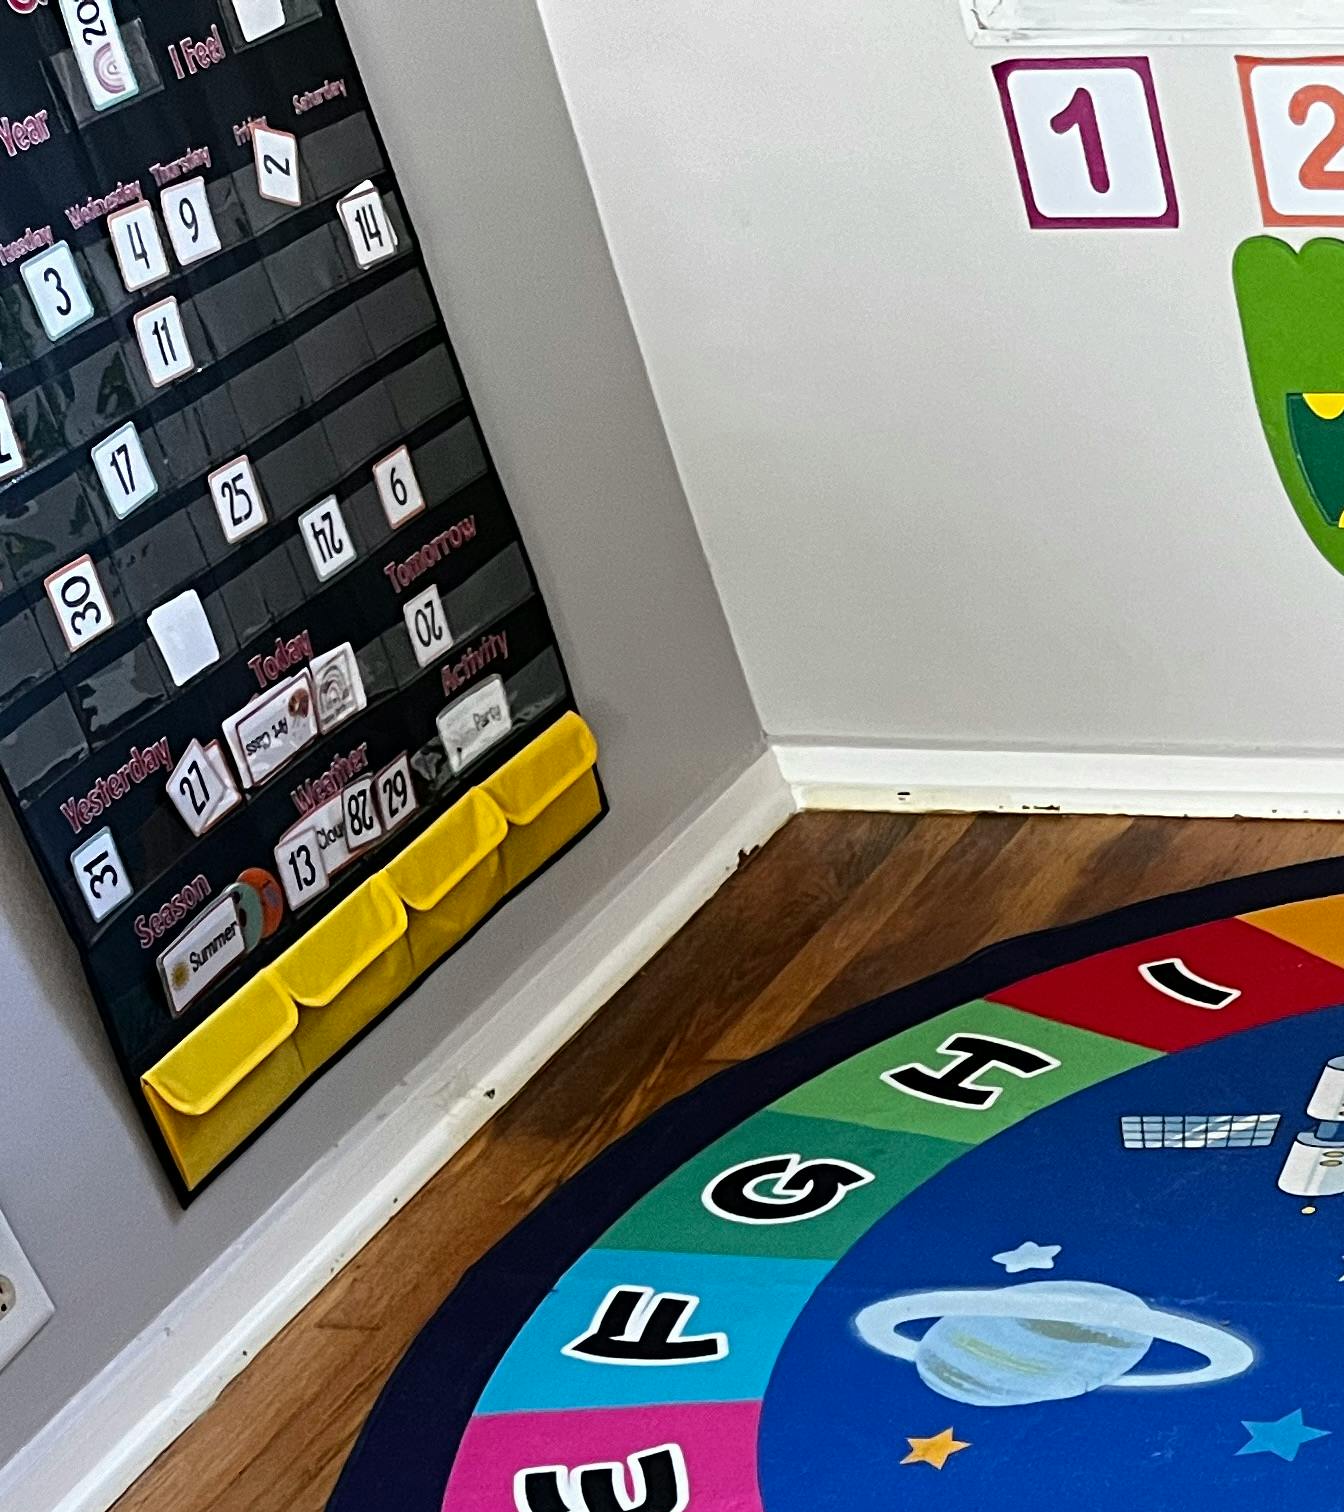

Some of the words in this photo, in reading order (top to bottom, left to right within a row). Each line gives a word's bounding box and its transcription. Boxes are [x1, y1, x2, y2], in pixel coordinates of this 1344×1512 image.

[168, 44, 185, 79] I
[181, 24, 227, 75] Feel
[293, 79, 347, 115] Saturday
[149, 147, 212, 187] Thursday
[263, 154, 290, 176] 2
[1049, 87, 1110, 194] 1
[64, 180, 143, 230] Wednesday
[354, 204, 383, 252] 14
[129, 221, 151, 270] 4
[43, 267, 72, 316] 3
[152, 317, 177, 366] 11
[110, 443, 136, 496] 17
[390, 467, 408, 506] 6
[221, 472, 253, 527] 25
[384, 514, 477, 594] Tomorrow
[61, 575, 101, 636] 30
[248, 629, 314, 688] Today
[440, 630, 509, 697] Activity
[59, 736, 174, 834] Yesterday
[180, 760, 210, 816] 27
[290, 742, 368, 816] Weather
[383, 770, 408, 818] 29
[83, 850, 118, 899] 31
[289, 844, 316, 892] 13
[134, 874, 212, 949] Season
[189, 922, 237, 972] Summer
[1138, 955, 1241, 1010] I
[880, 1032, 1062, 1109] H
[701, 1152, 877, 1225] G
[562, 1284, 728, 1366] F
